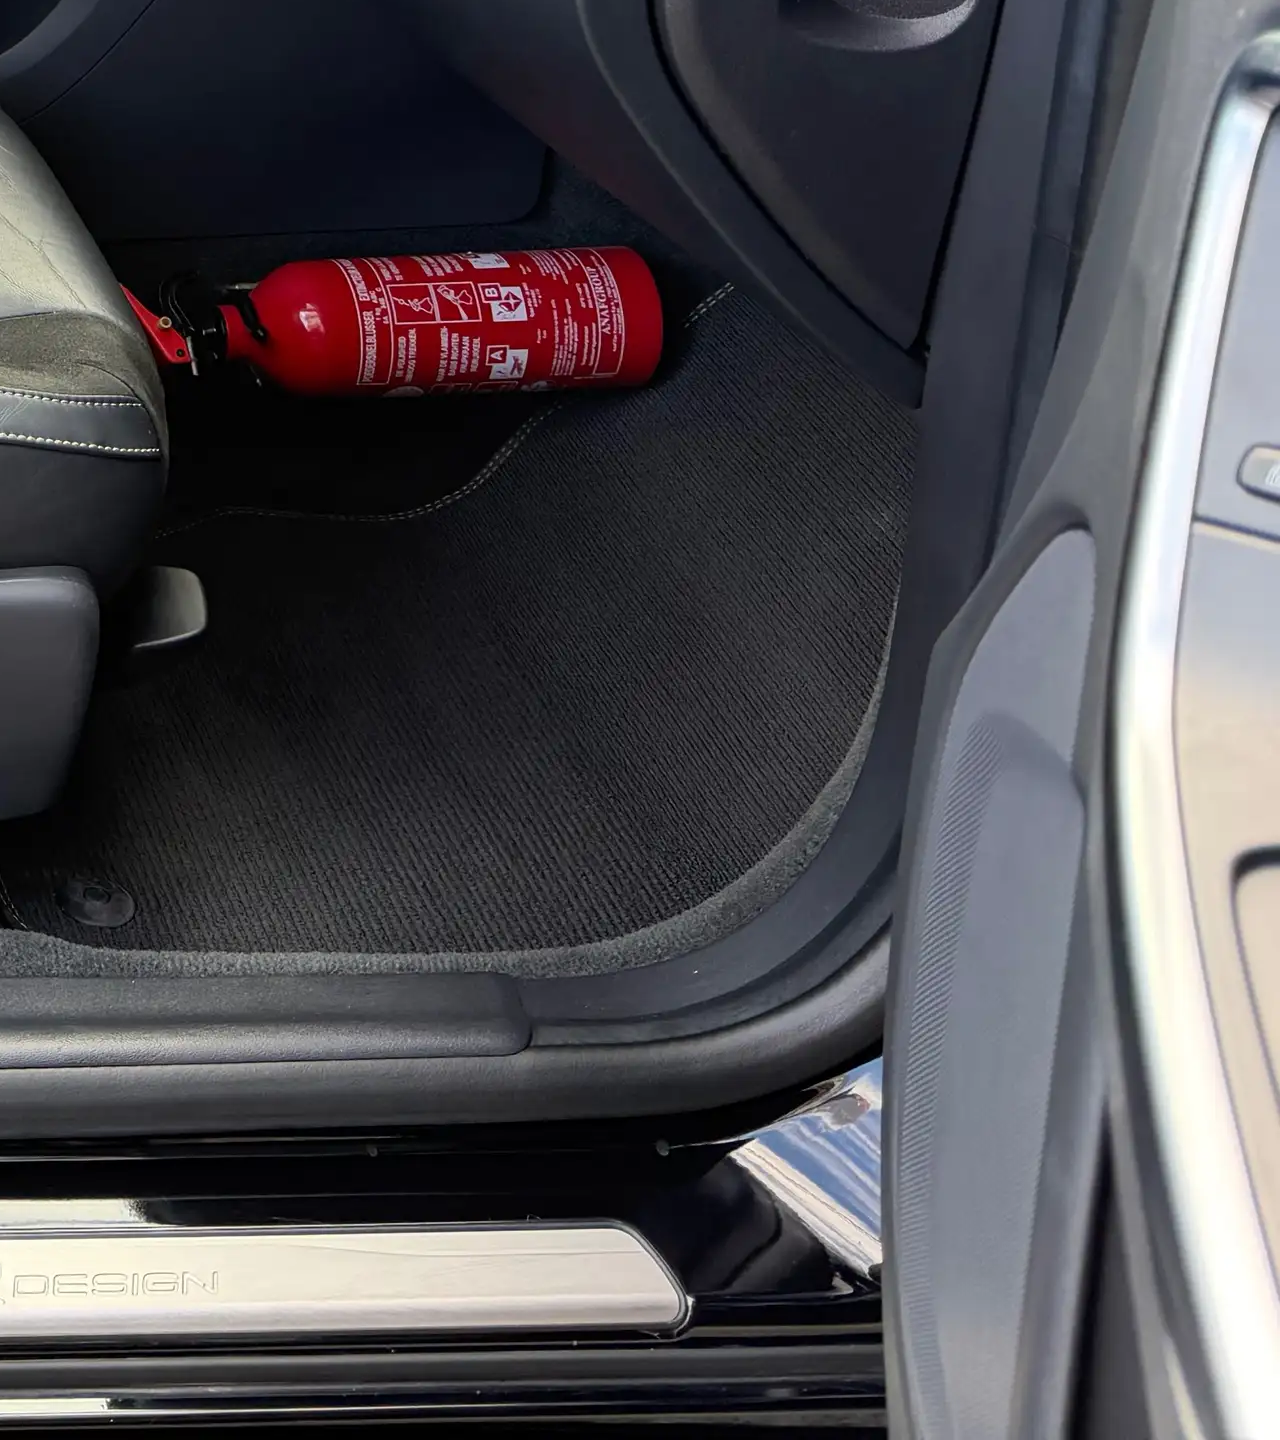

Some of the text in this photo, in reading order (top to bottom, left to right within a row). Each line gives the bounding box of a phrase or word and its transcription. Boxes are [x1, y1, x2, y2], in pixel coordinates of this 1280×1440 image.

[485, 287, 497, 298] B
[586, 266, 612, 335] ANAFGROUP
[489, 349, 504, 360] A
[12, 1271, 219, 1298] DESIGN
